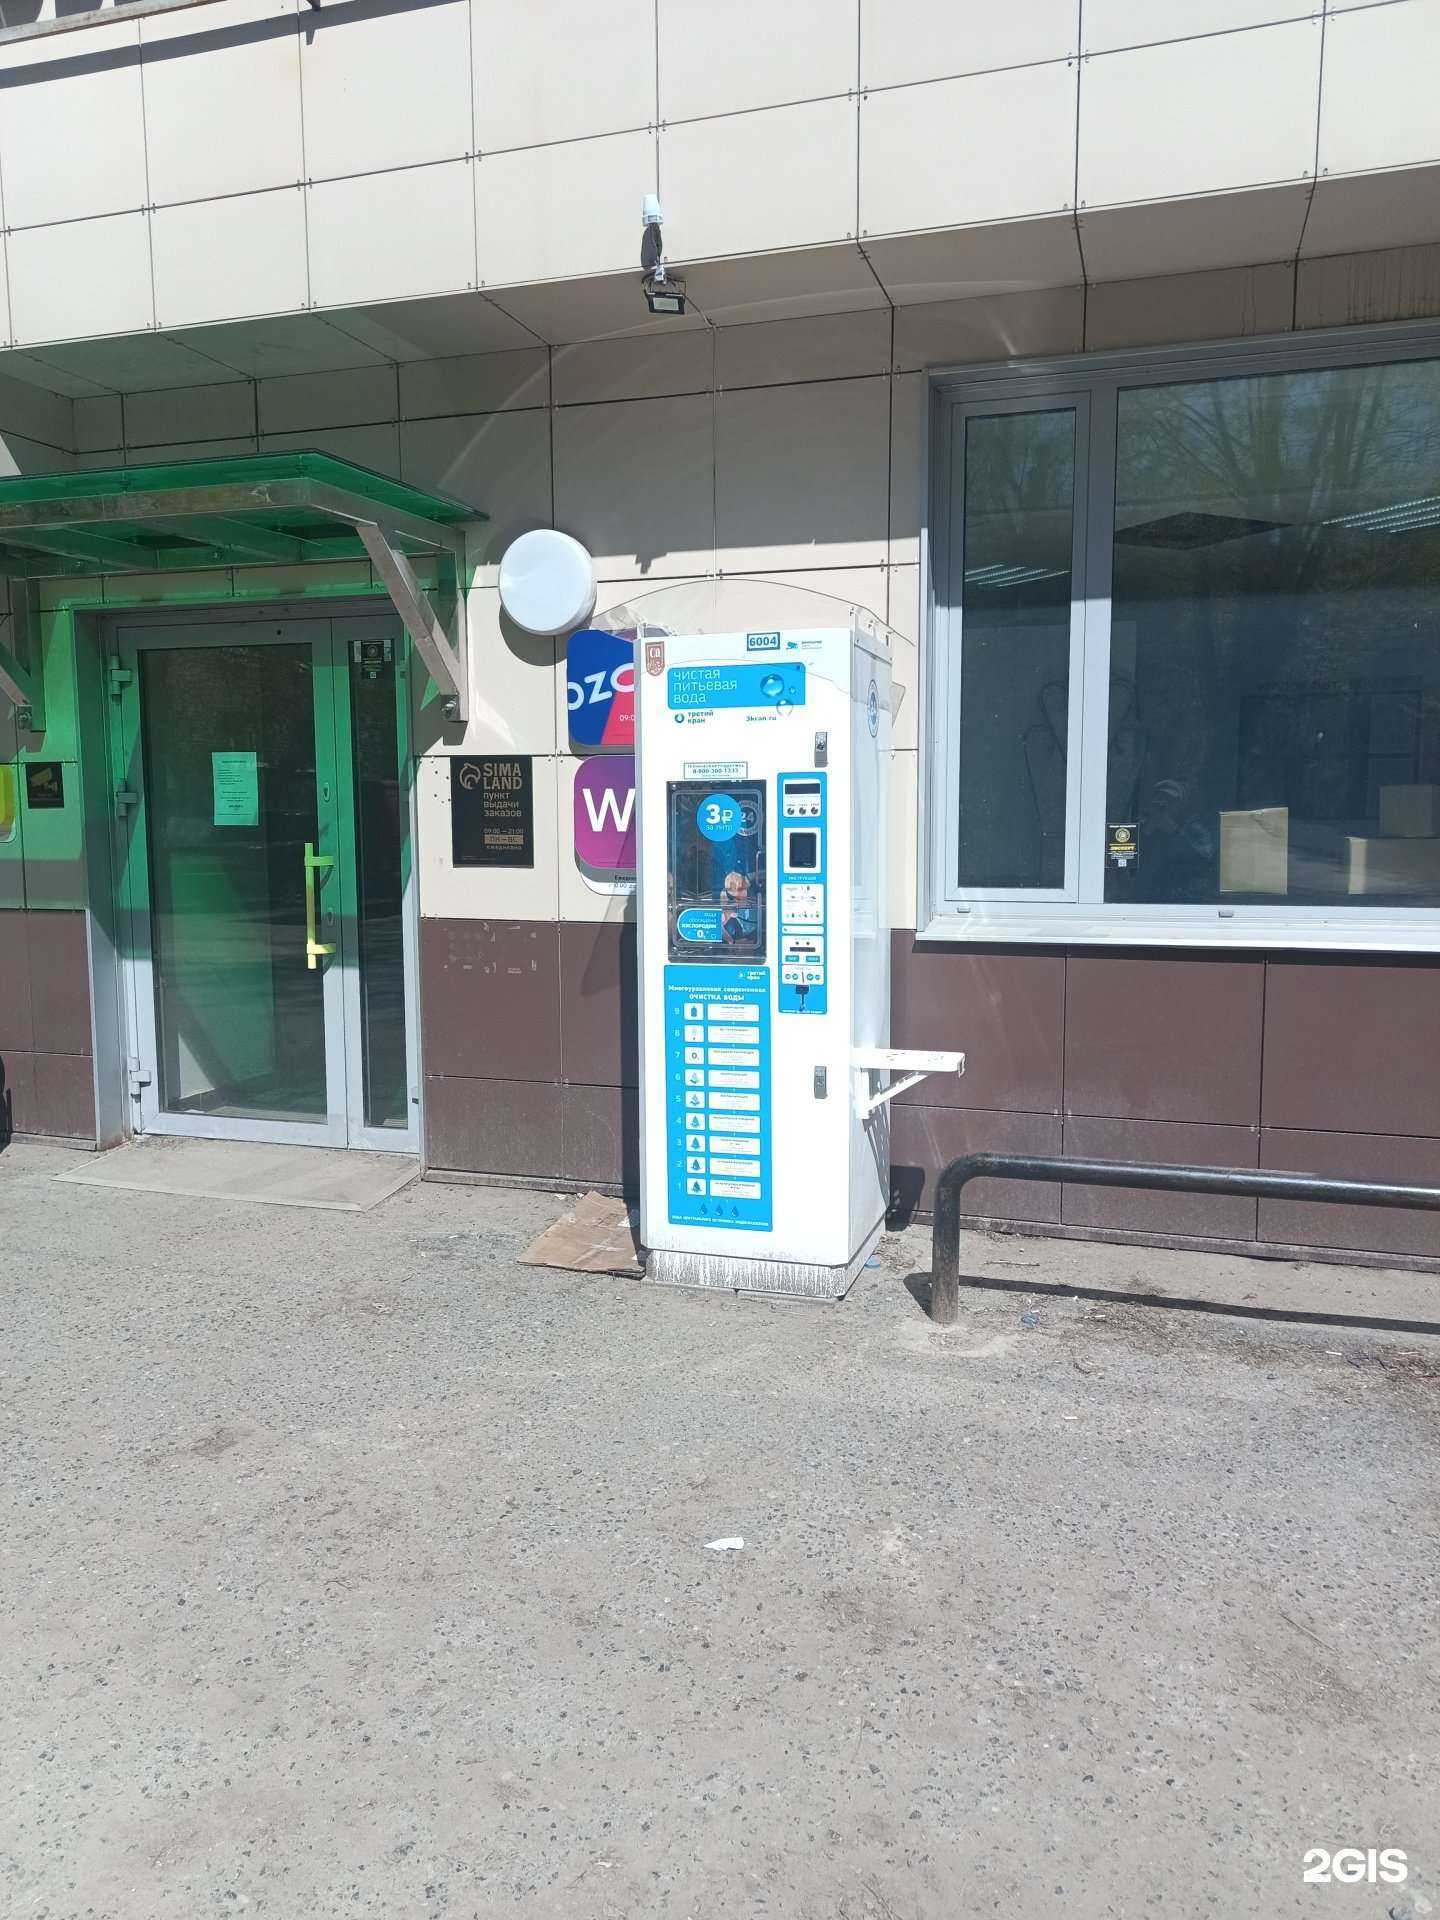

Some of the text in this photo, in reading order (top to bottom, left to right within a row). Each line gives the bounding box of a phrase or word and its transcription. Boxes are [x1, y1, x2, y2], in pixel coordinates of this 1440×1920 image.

[750, 636, 777, 647] 6004
[673, 669, 720, 680] чистая
[673, 680, 738, 691] питьевая
[673, 693, 706, 704] вода
[483, 763, 522, 777] SIMA
[483, 777, 523, 790] LAND
[483, 792, 511, 800] пункт
[483, 801, 519, 809] выдачи
[483, 809, 522, 817] заказов
